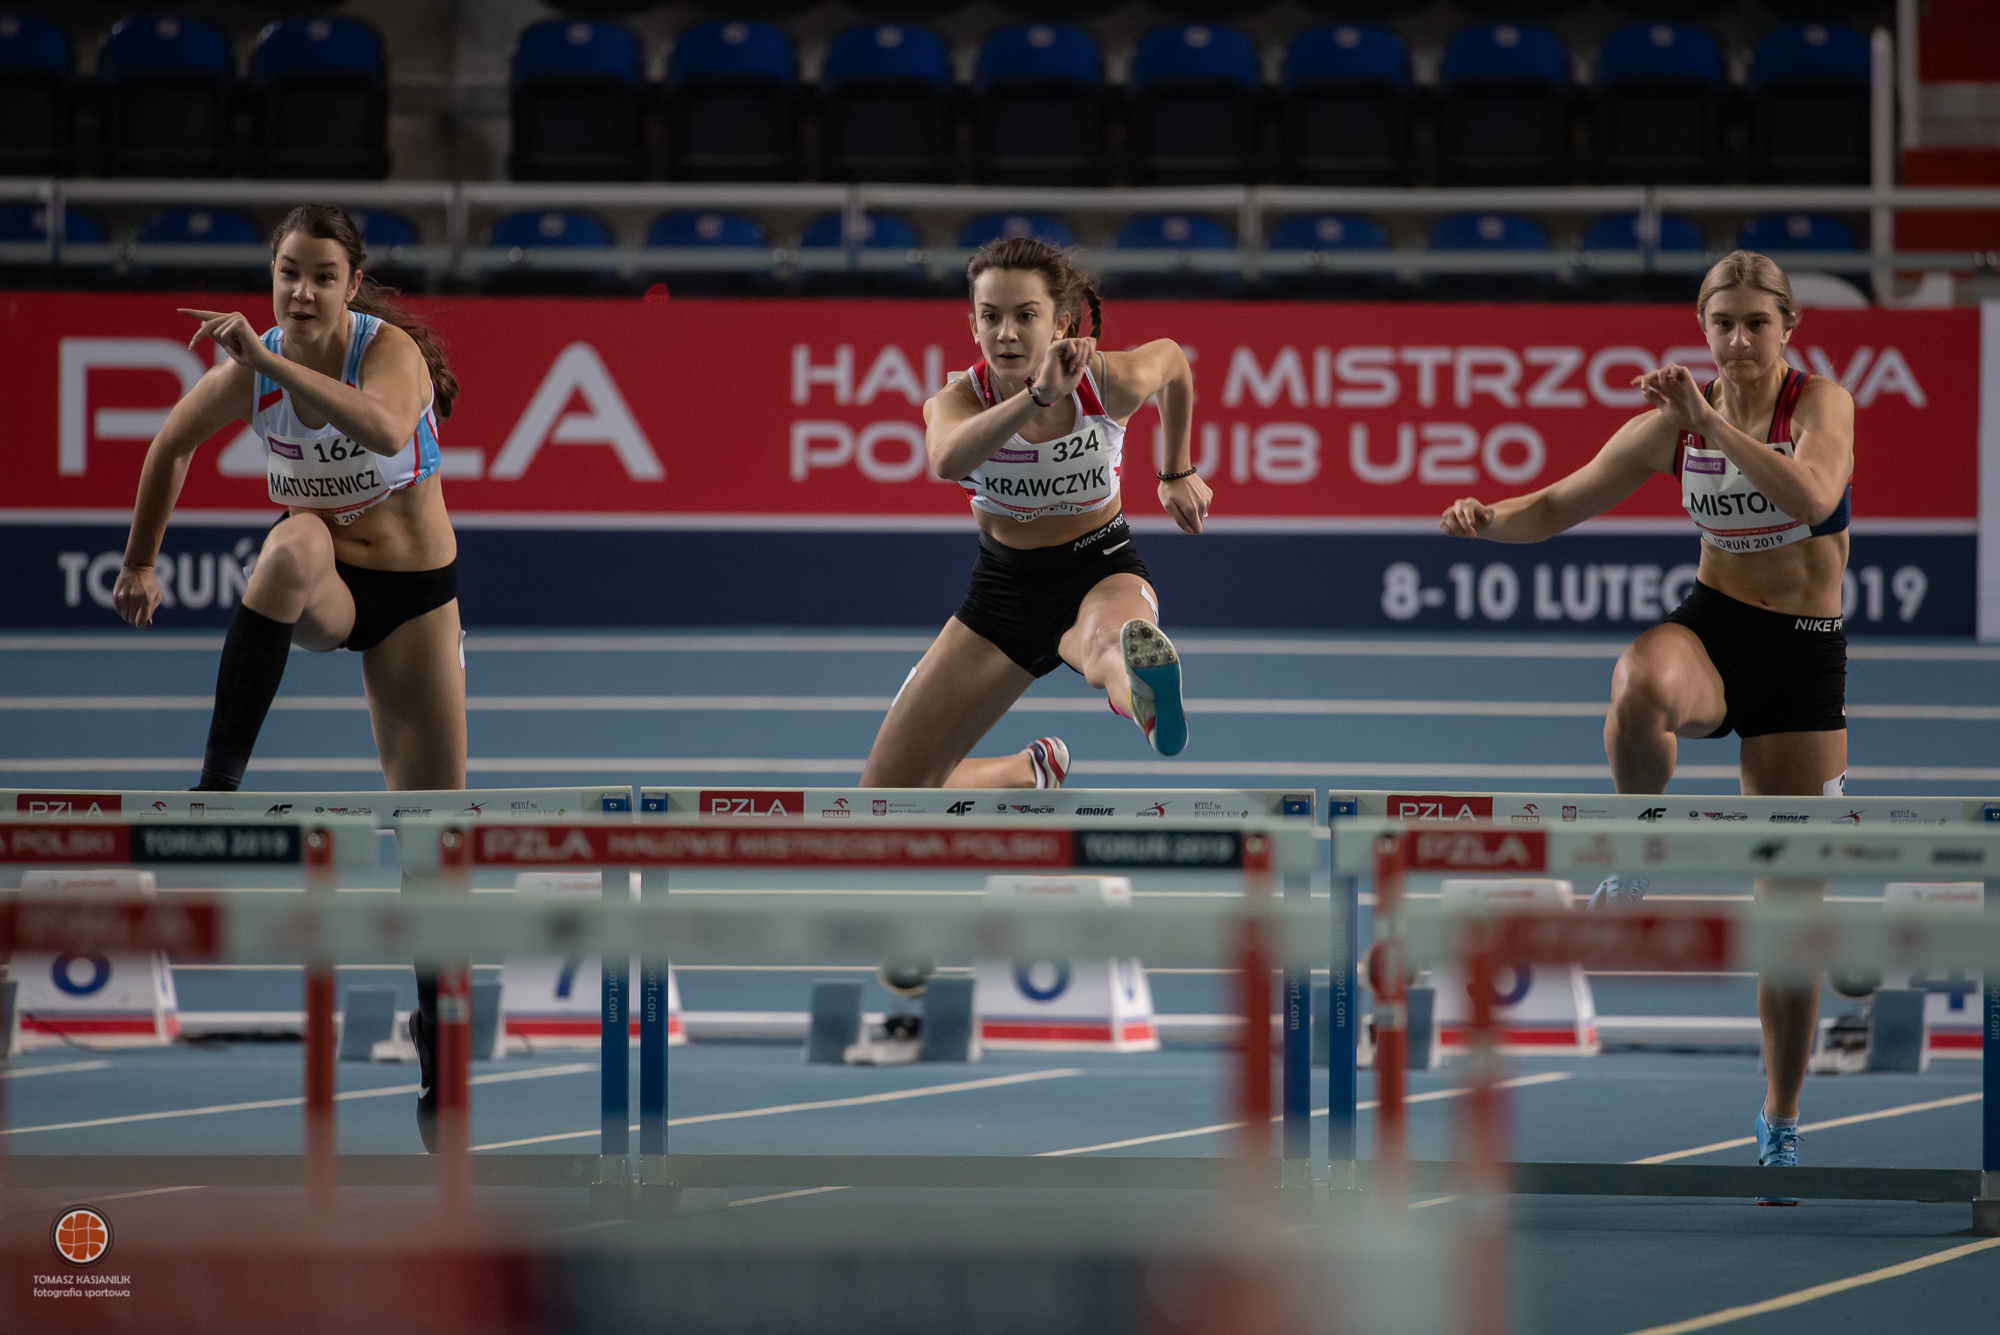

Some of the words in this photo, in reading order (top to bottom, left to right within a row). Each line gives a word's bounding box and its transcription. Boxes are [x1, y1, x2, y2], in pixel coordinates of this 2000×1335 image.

[1052, 429, 1100, 463] 324
[1348, 421, 1547, 486] U20
[270, 469, 380, 497] MATUSZEWICZ
[985, 466, 1106, 497] KRAWCZYK
[1690, 491, 1776, 516] MISTO
[1073, 527, 1107, 552] NIKE
[1754, 534, 1783, 549] 2019
[1380, 563, 1519, 622] 8-10
[1794, 618, 1833, 632] NIKE
[29, 801, 105, 819] PZLA
[264, 804, 293, 819] 4F
[392, 809, 432, 818] 4MOVE
[511, 801, 530, 809] NESTLÉ
[711, 798, 788, 817] PZLA
[946, 801, 976, 816] 4F
[1075, 807, 1115, 816] 4MOVE
[1194, 801, 1213, 810] NESTLÉ
[1399, 802, 1477, 822] PZLA
[1891, 809, 1910, 818] NESTLÉ
[1637, 808, 1667, 823] 4F
[1769, 815, 1809, 824] 4MOVE
[483, 828, 594, 861] PZLA
[1415, 831, 1531, 866] PZLA
